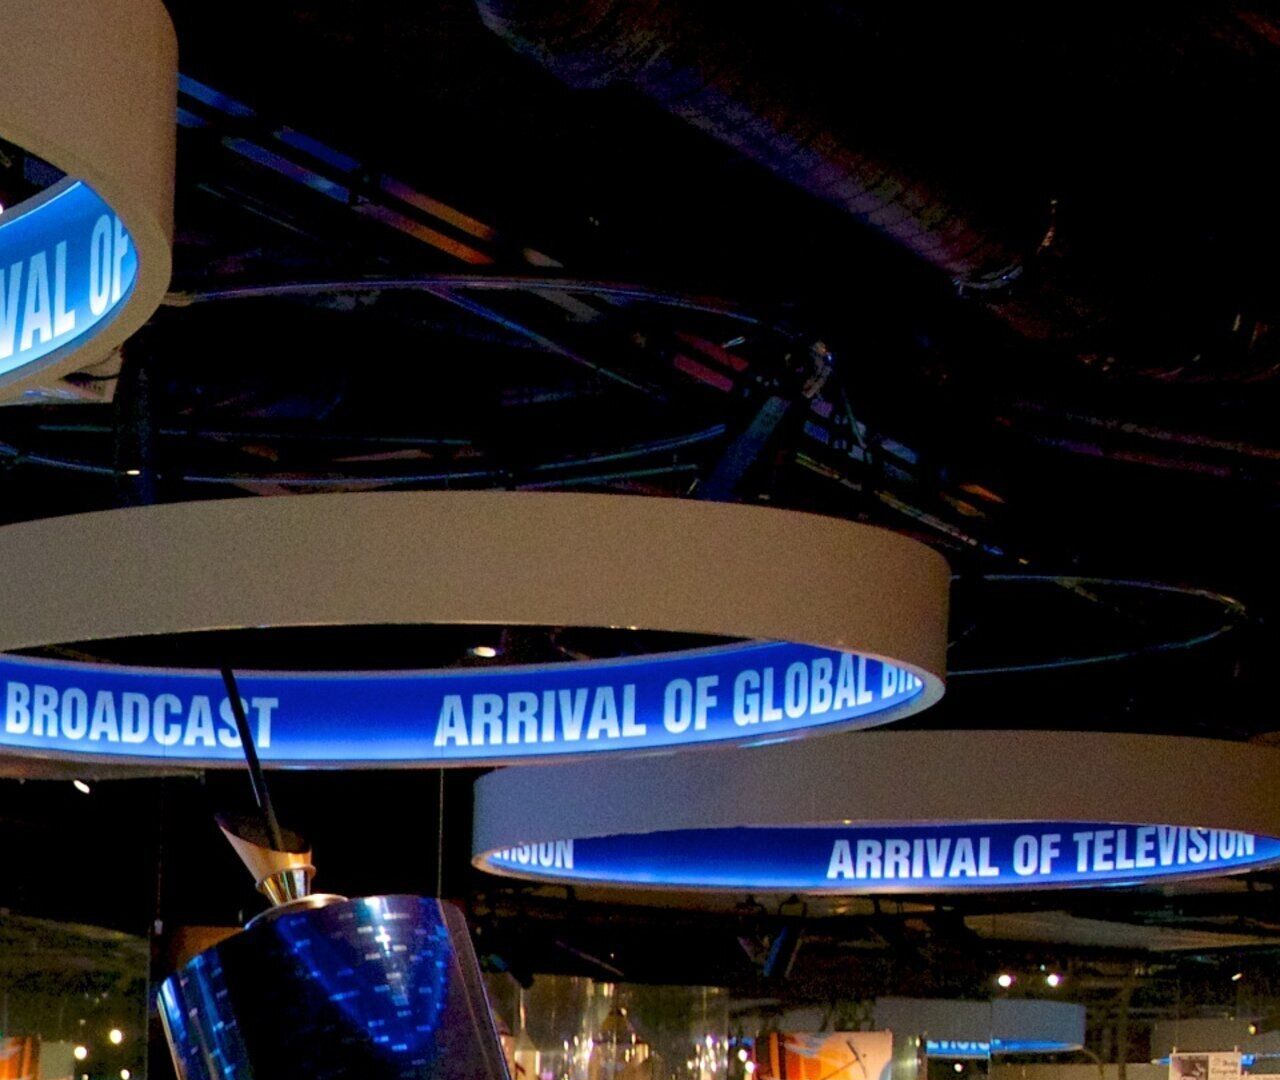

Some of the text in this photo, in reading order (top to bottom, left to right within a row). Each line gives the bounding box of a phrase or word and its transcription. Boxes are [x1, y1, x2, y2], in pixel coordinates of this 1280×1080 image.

[5, 681, 278, 749] BROADCAST
[434, 684, 646, 747] ARRIVAL
[662, 675, 719, 735] OF
[732, 653, 873, 726] GLOBAL
[826, 837, 1000, 880] ARRIVAL
[1012, 834, 1064, 877] OF
